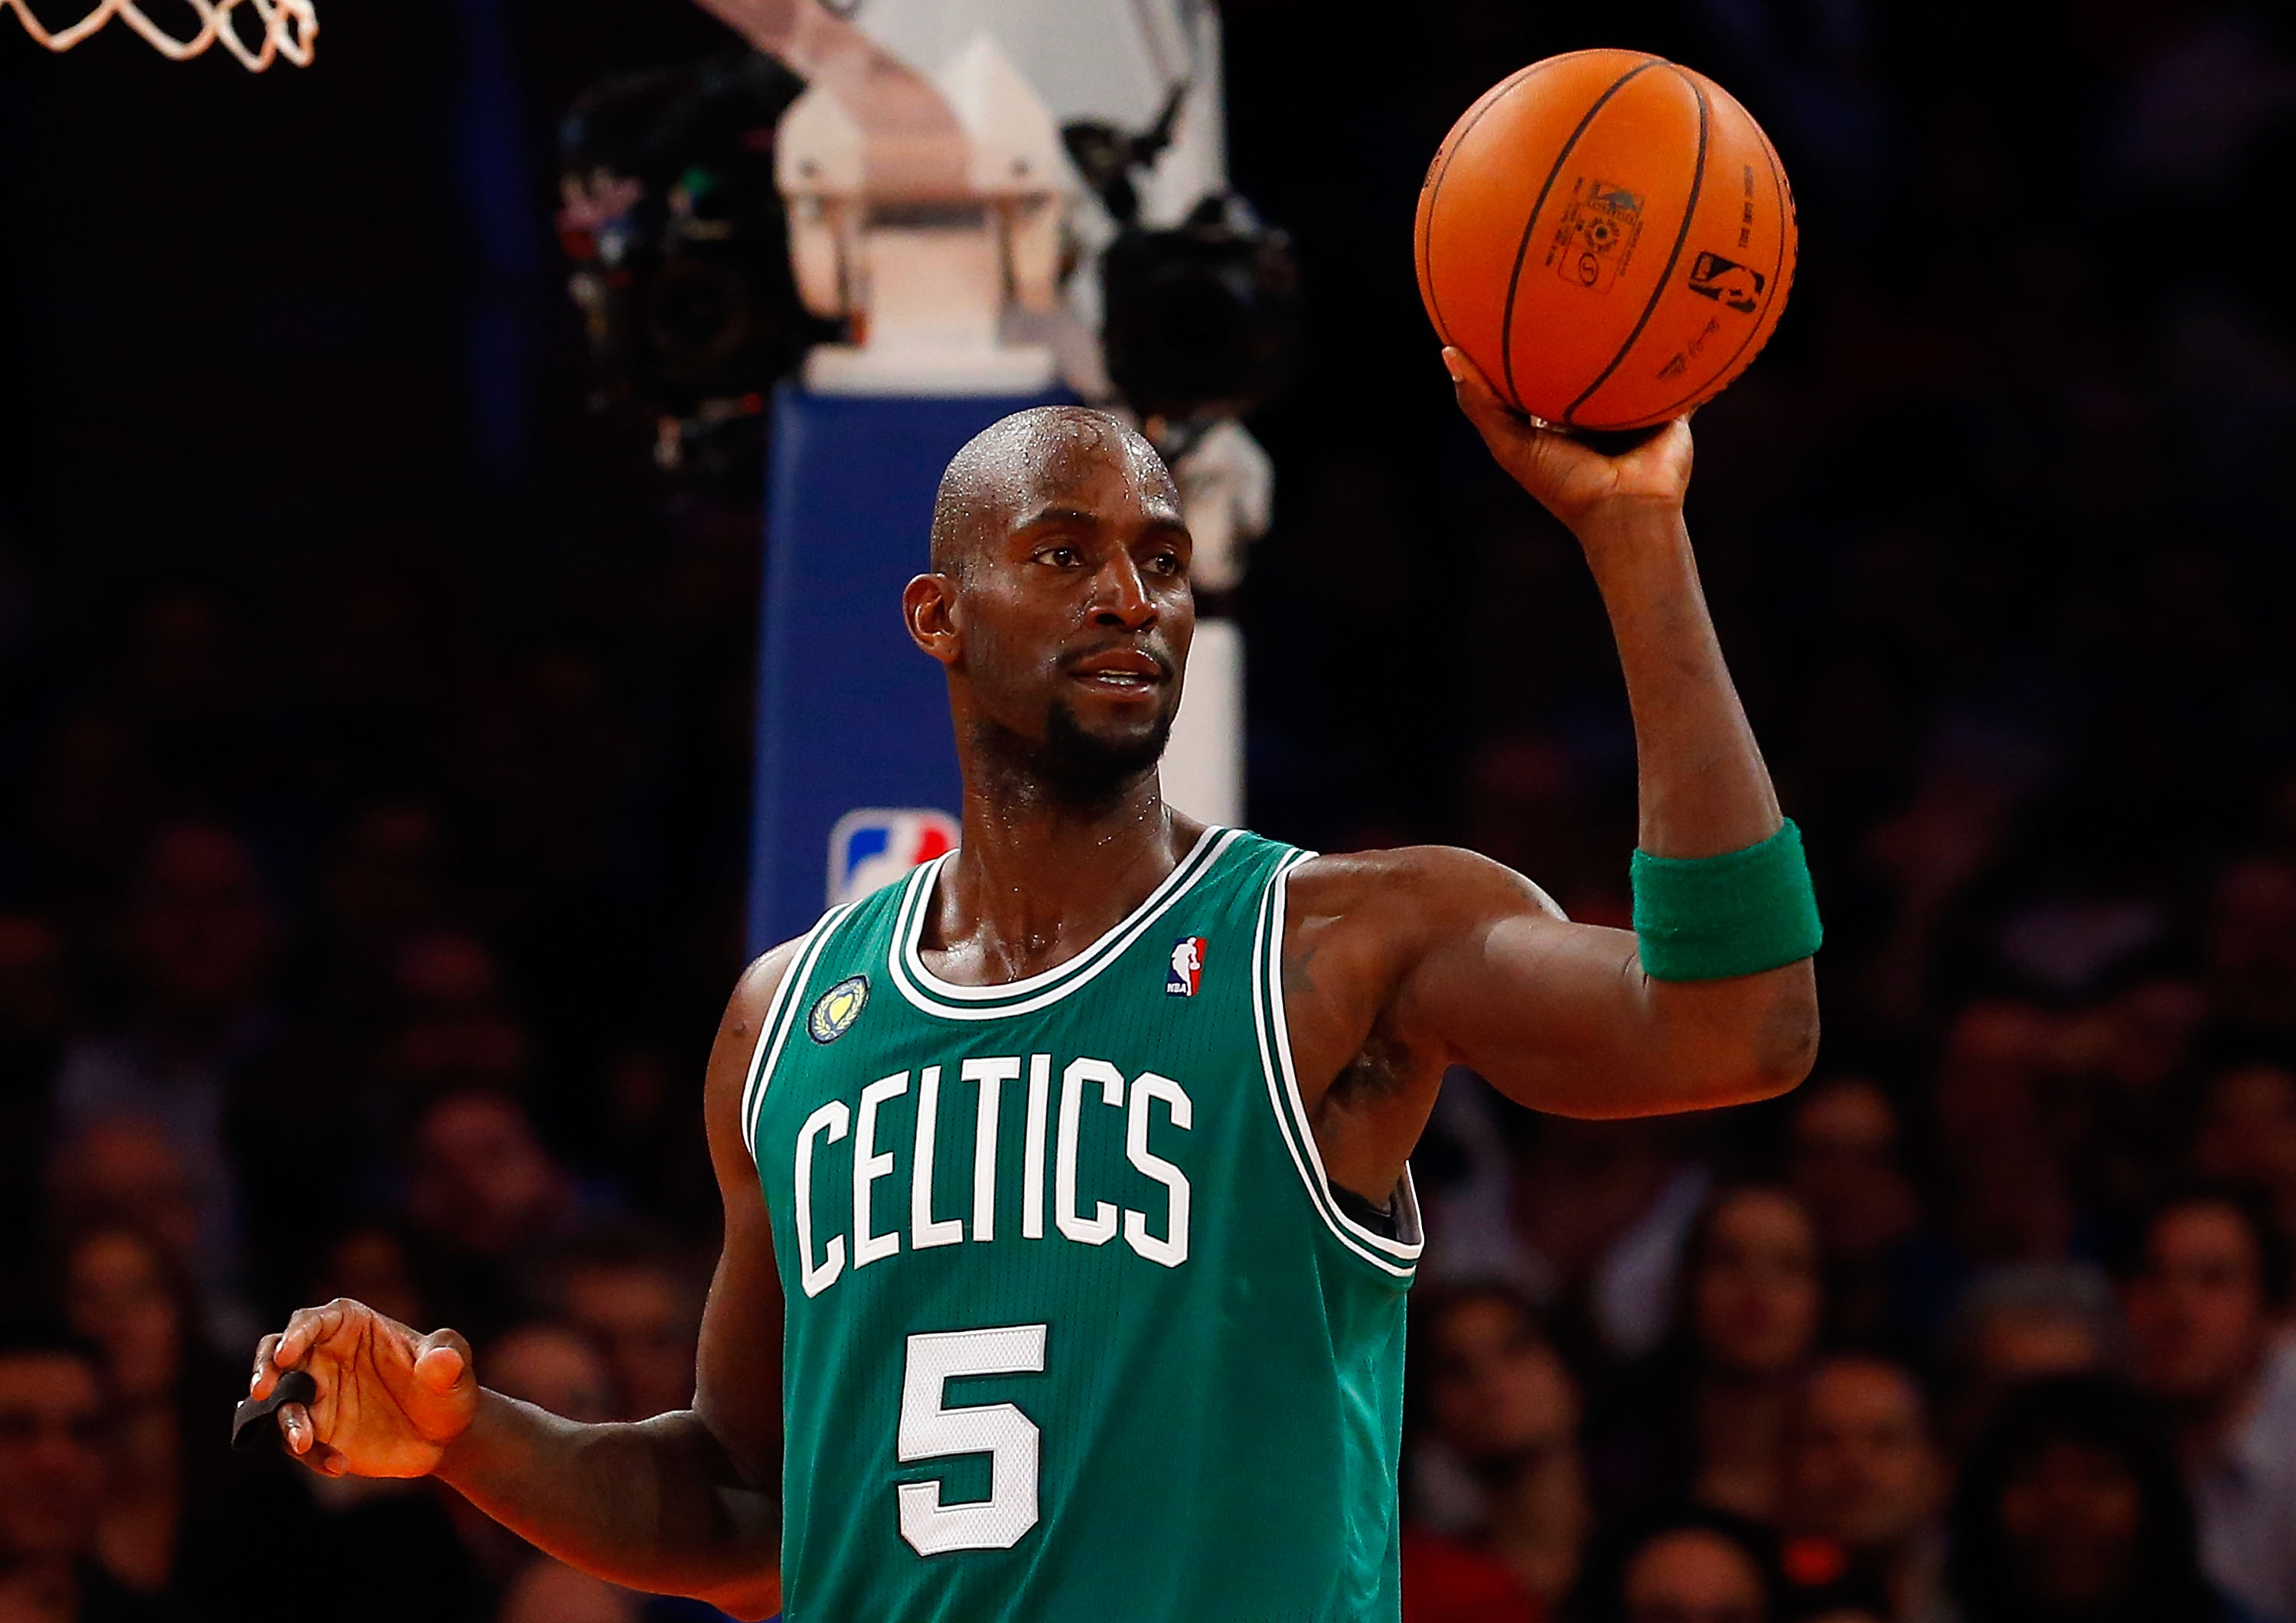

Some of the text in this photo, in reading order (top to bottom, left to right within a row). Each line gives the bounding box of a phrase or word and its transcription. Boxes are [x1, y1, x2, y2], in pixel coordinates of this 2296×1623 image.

[1166, 982, 1186, 993] NBA
[794, 1053, 1193, 1299] CELTICS
[897, 1324, 1047, 1557] 5
